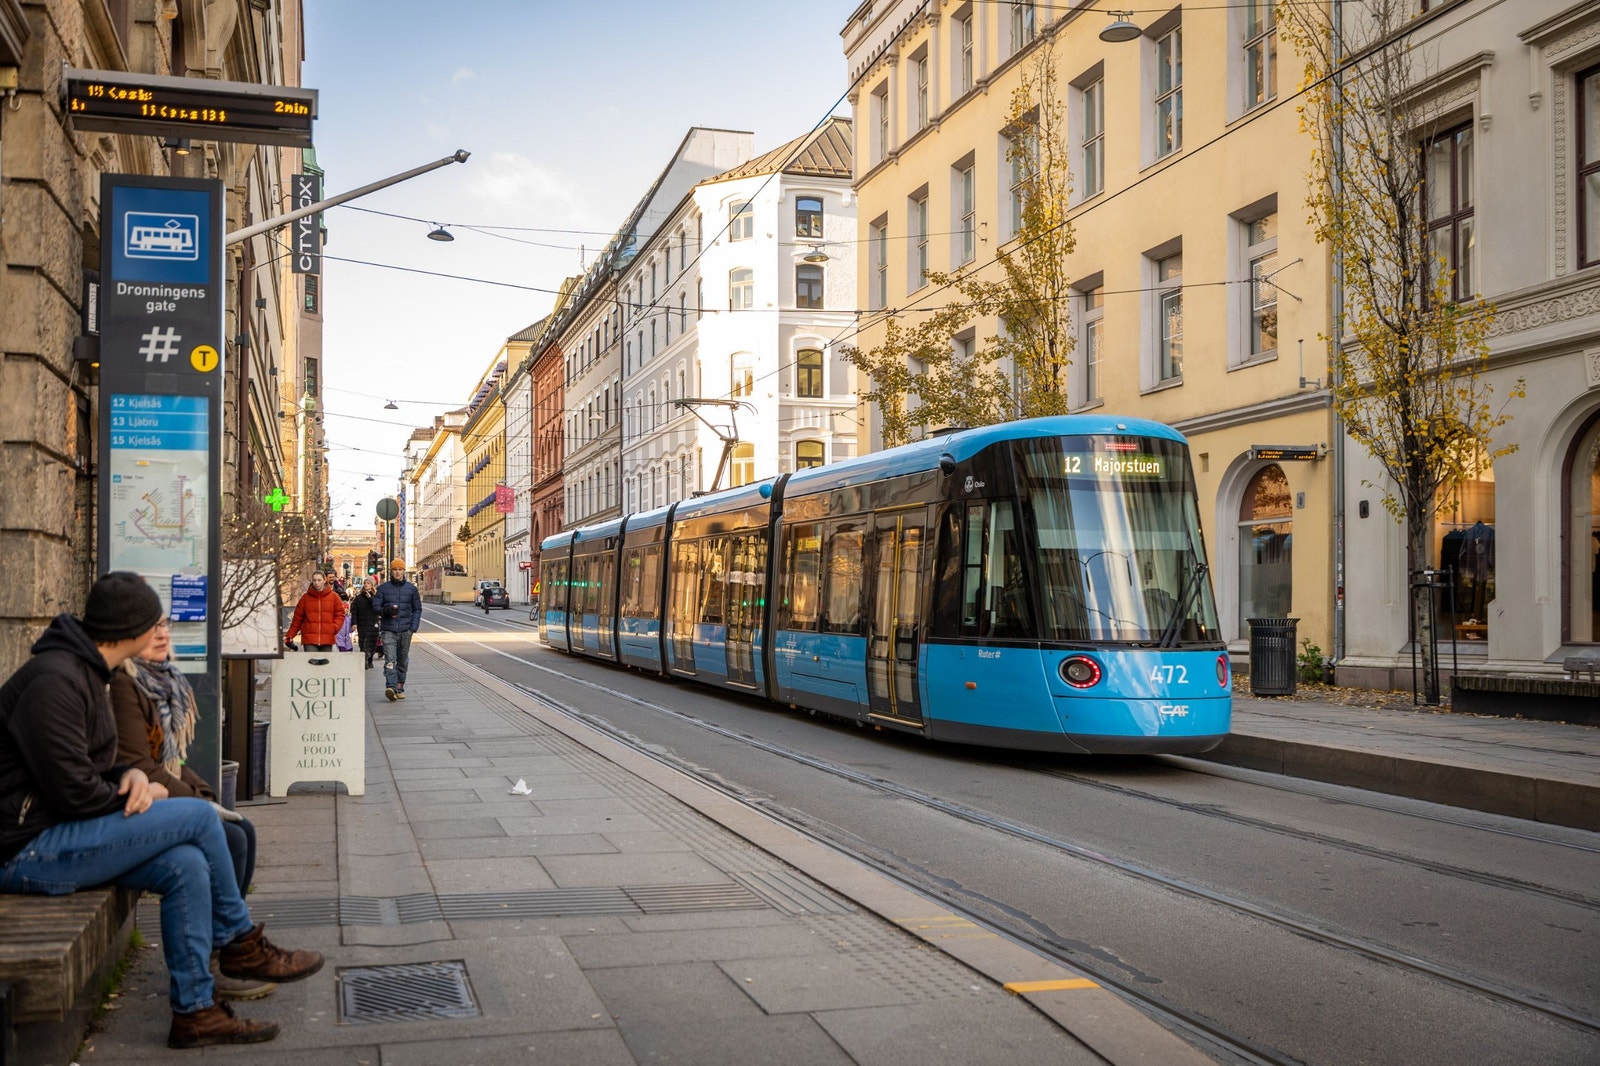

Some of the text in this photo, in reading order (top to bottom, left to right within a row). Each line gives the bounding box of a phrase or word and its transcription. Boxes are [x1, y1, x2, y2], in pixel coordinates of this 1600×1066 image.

[275, 101, 308, 114] 2min
[116, 282, 206, 300] Dronningens
[146, 301, 176, 313] gate
[199, 350, 210, 366] T
[113, 398, 162, 409] 12 Kjelsås
[113, 416, 159, 428] 13 Ljabru
[113, 435, 162, 447] 15 Kjelsås
[1064, 456, 1160, 475] 12 Majorstuen
[1150, 664, 1189, 684] 472
[1159, 705, 1189, 717] CAF
[301, 733, 338, 742] GREAT
[303, 746, 336, 755] FOOD
[296, 758, 343, 768] ALL DAY
